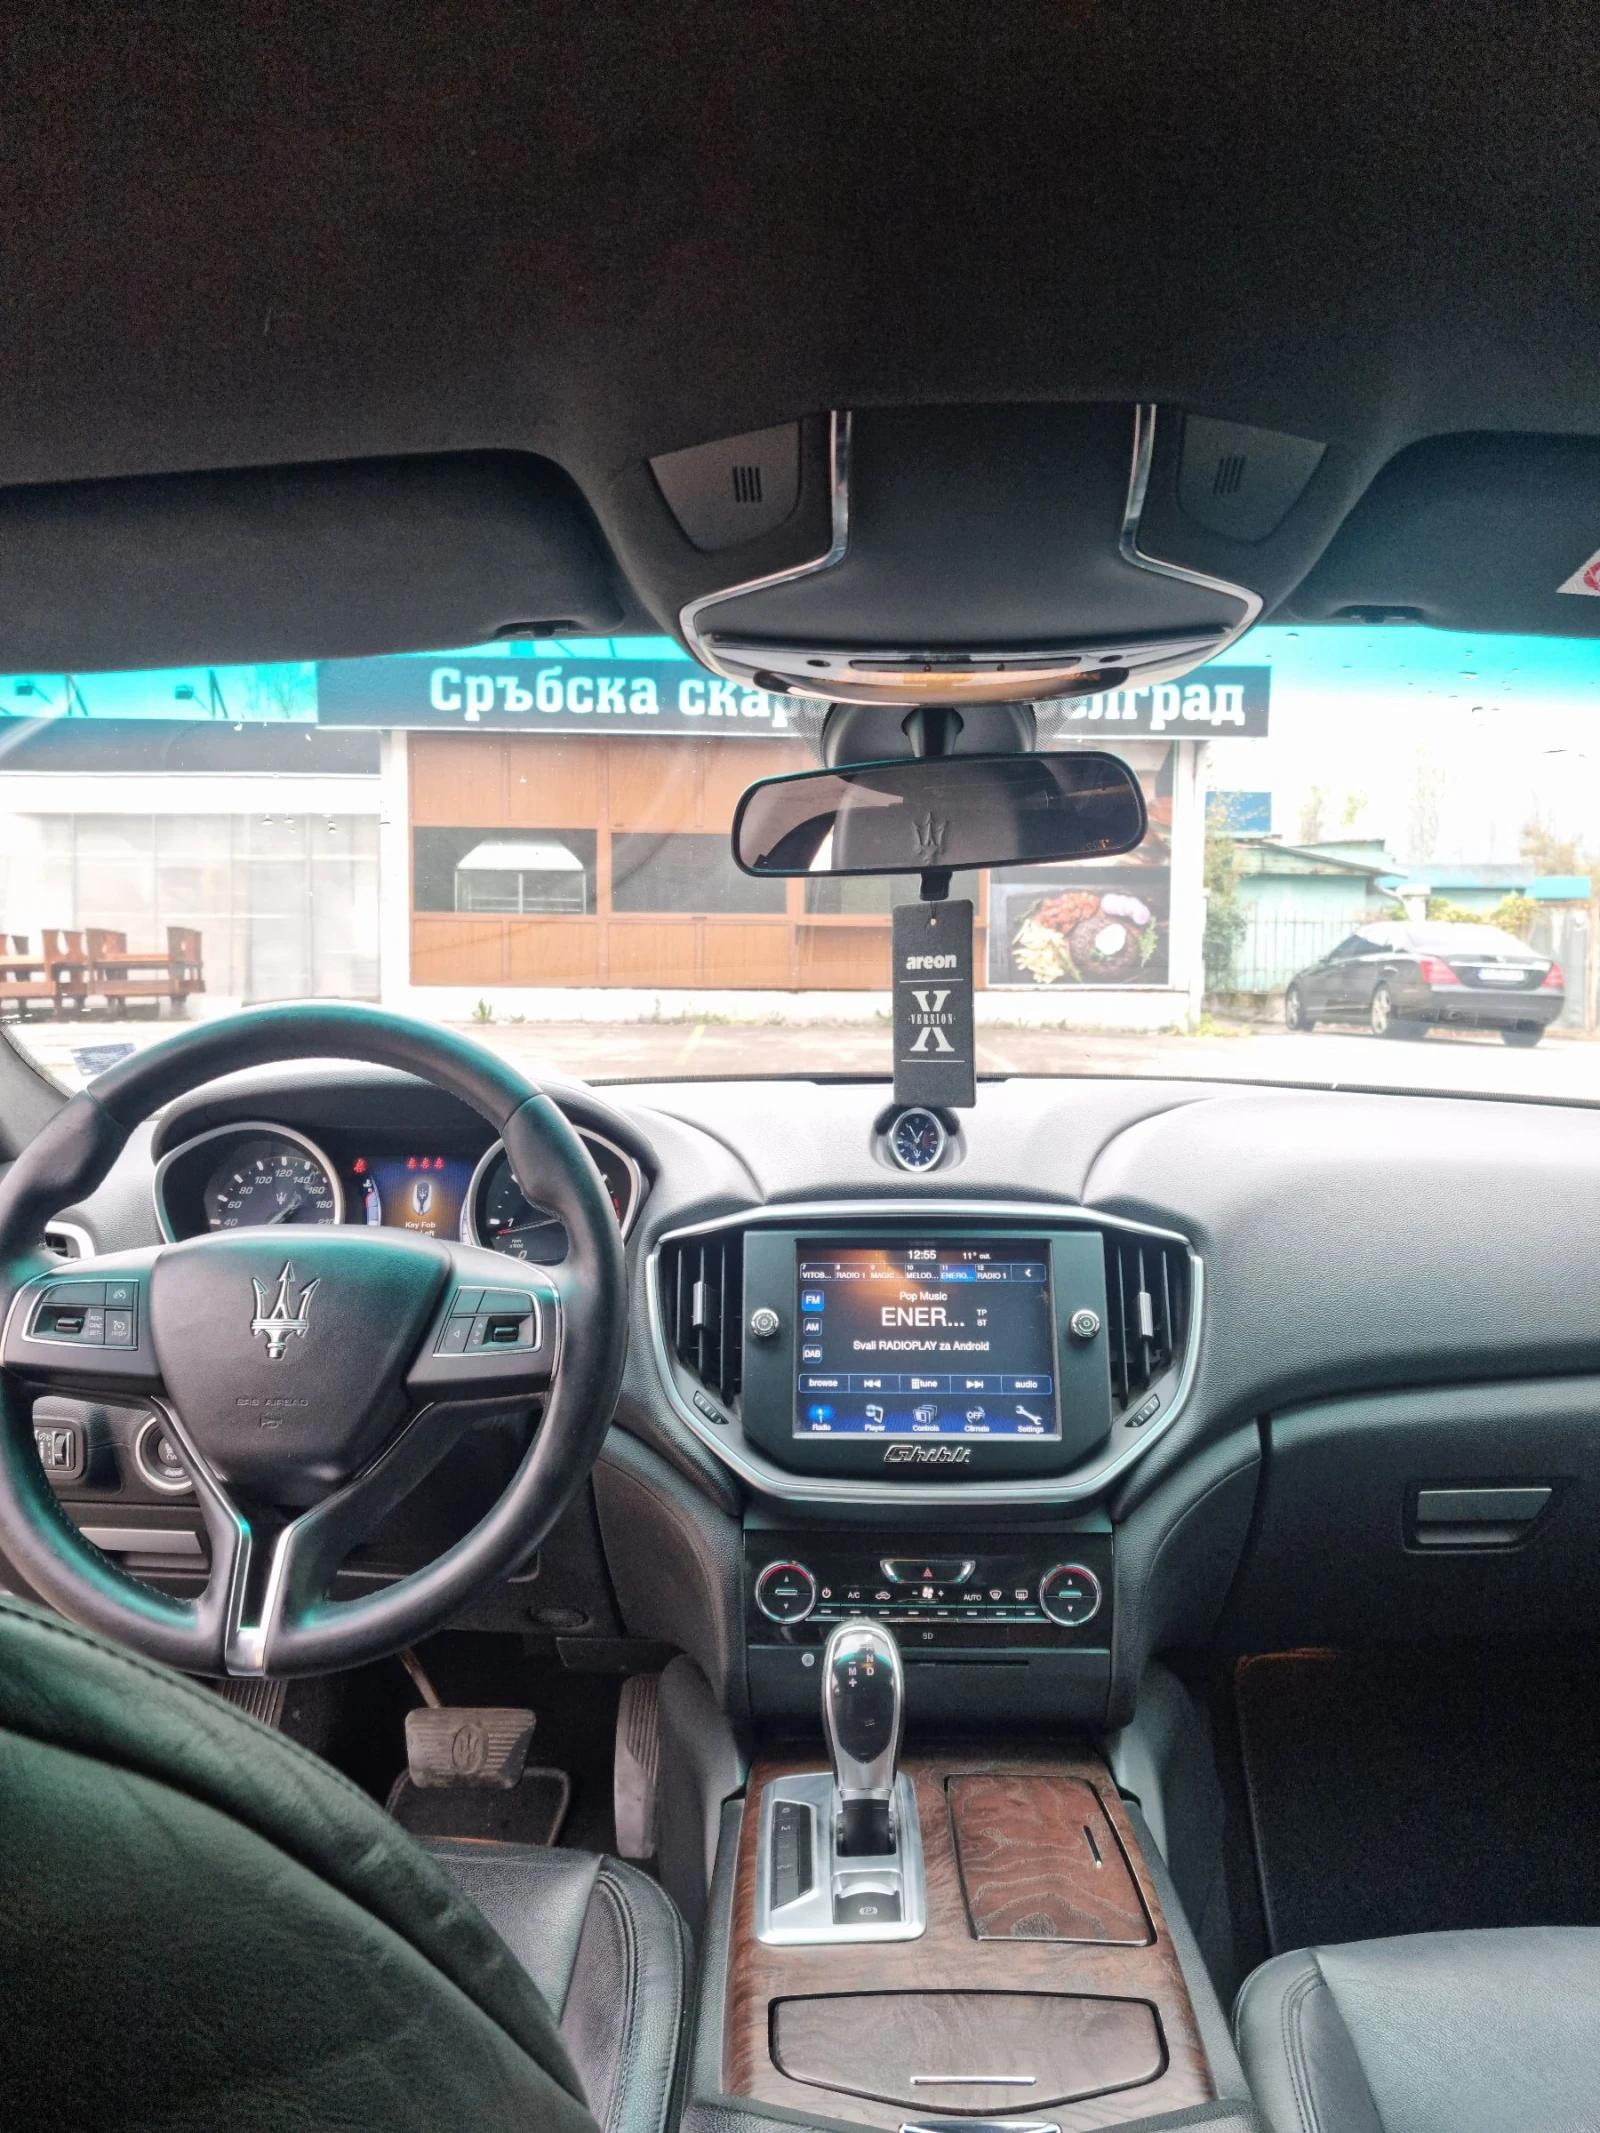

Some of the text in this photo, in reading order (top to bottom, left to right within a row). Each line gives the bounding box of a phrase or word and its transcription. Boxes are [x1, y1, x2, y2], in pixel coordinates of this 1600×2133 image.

[430, 666, 658, 721] Сръбска
[905, 954, 957, 970] areon
[275, 1169, 293, 1177] 120
[254, 1176, 272, 1184] 100
[293, 1176, 310, 1184] 140
[227, 1201, 242, 1209] 60
[405, 1221, 419, 1229] Key
[908, 1250, 937, 1260] 12:55
[977, 1272, 1001, 1280] RADIO
[805, 1296, 821, 1305] FM
[899, 1291, 948, 1302] Pop Music
[881, 1307, 965, 1326] ENER...
[805, 1323, 820, 1331] AM
[976, 1319, 987, 1327] ST
[853, 1340, 990, 1351] Svali RADIOPLAY za Android
[804, 1349, 821, 1358] DAB
[808, 1378, 838, 1387] browse
[919, 1379, 938, 1388] tune
[1014, 1380, 1038, 1389] audio
[966, 1411, 983, 1419] OFF
[864, 1424, 885, 1432] Player
[912, 1424, 940, 1432] Controls
[1017, 1425, 1044, 1434] Settings
[883, 1445, 972, 1464] Ghibli
[847, 1590, 860, 1600] A/C
[963, 1593, 982, 1601] AUTO
[922, 1632, 933, 1640] SD
[866, 1654, 874, 1662] N
[848, 1667, 857, 1676] M
[866, 1667, 875, 1676] D
